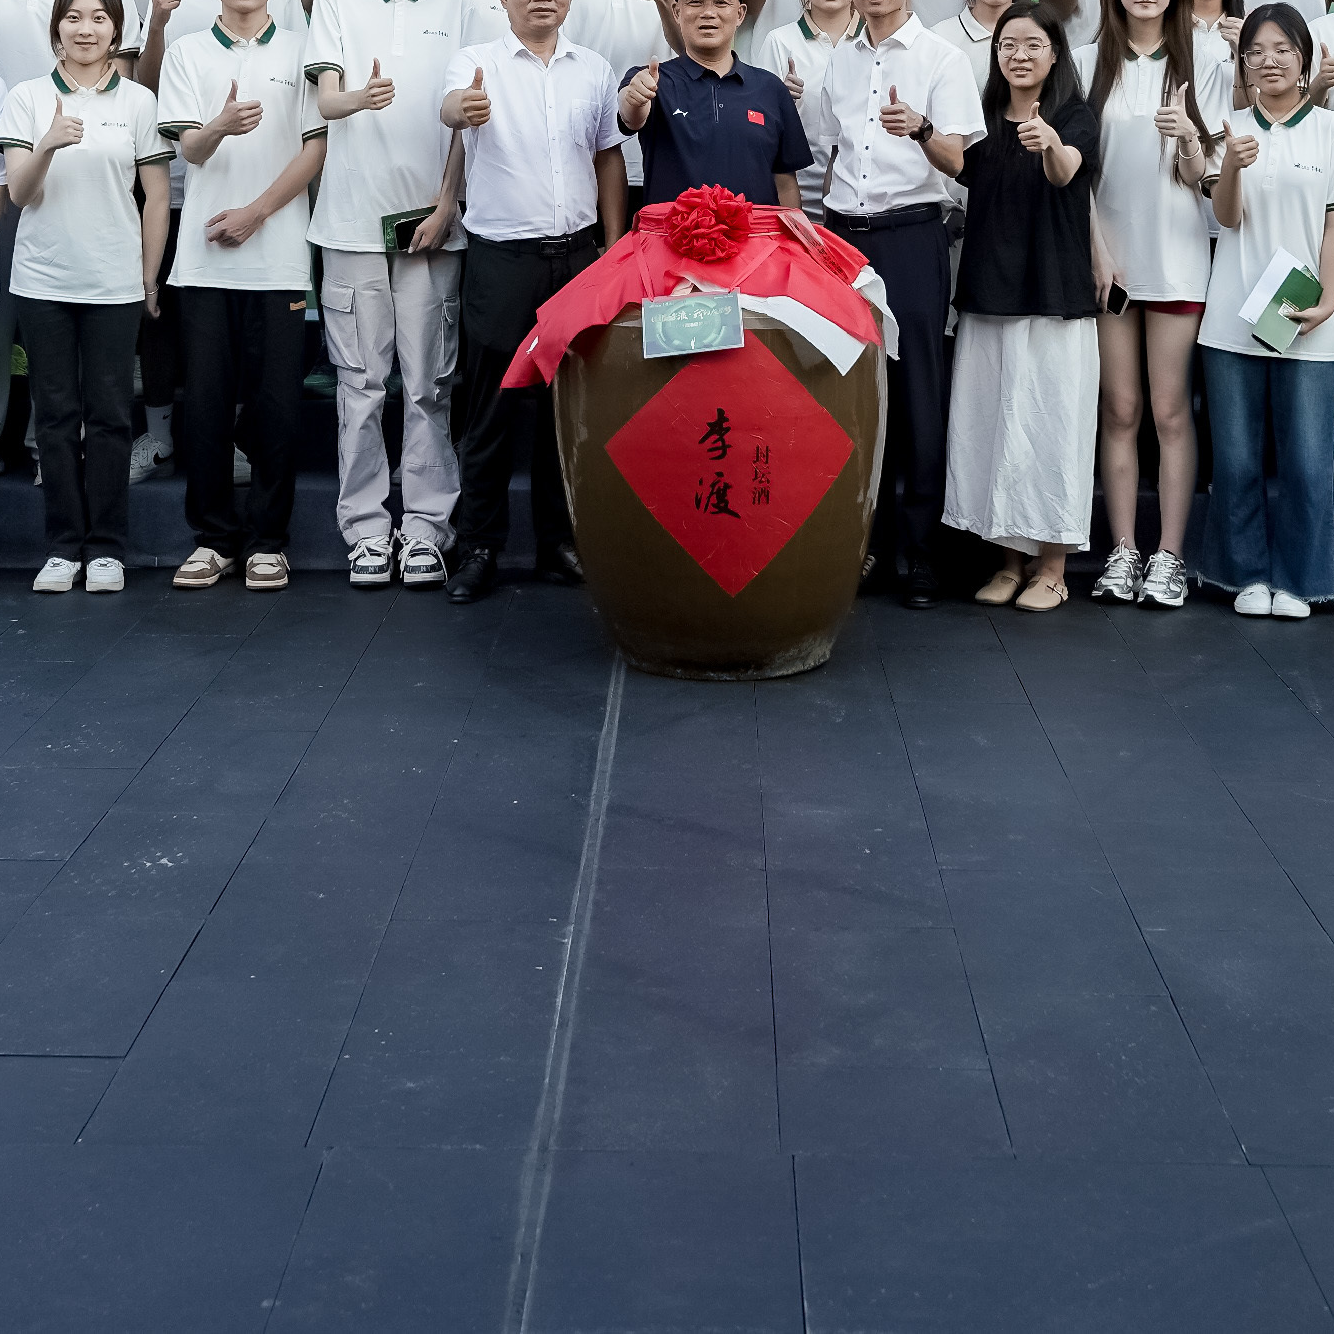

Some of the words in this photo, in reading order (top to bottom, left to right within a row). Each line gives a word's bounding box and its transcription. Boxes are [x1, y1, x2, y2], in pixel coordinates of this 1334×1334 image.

[694, 408, 742, 519] 李渡
[752, 444, 771, 506] 封坛酒
